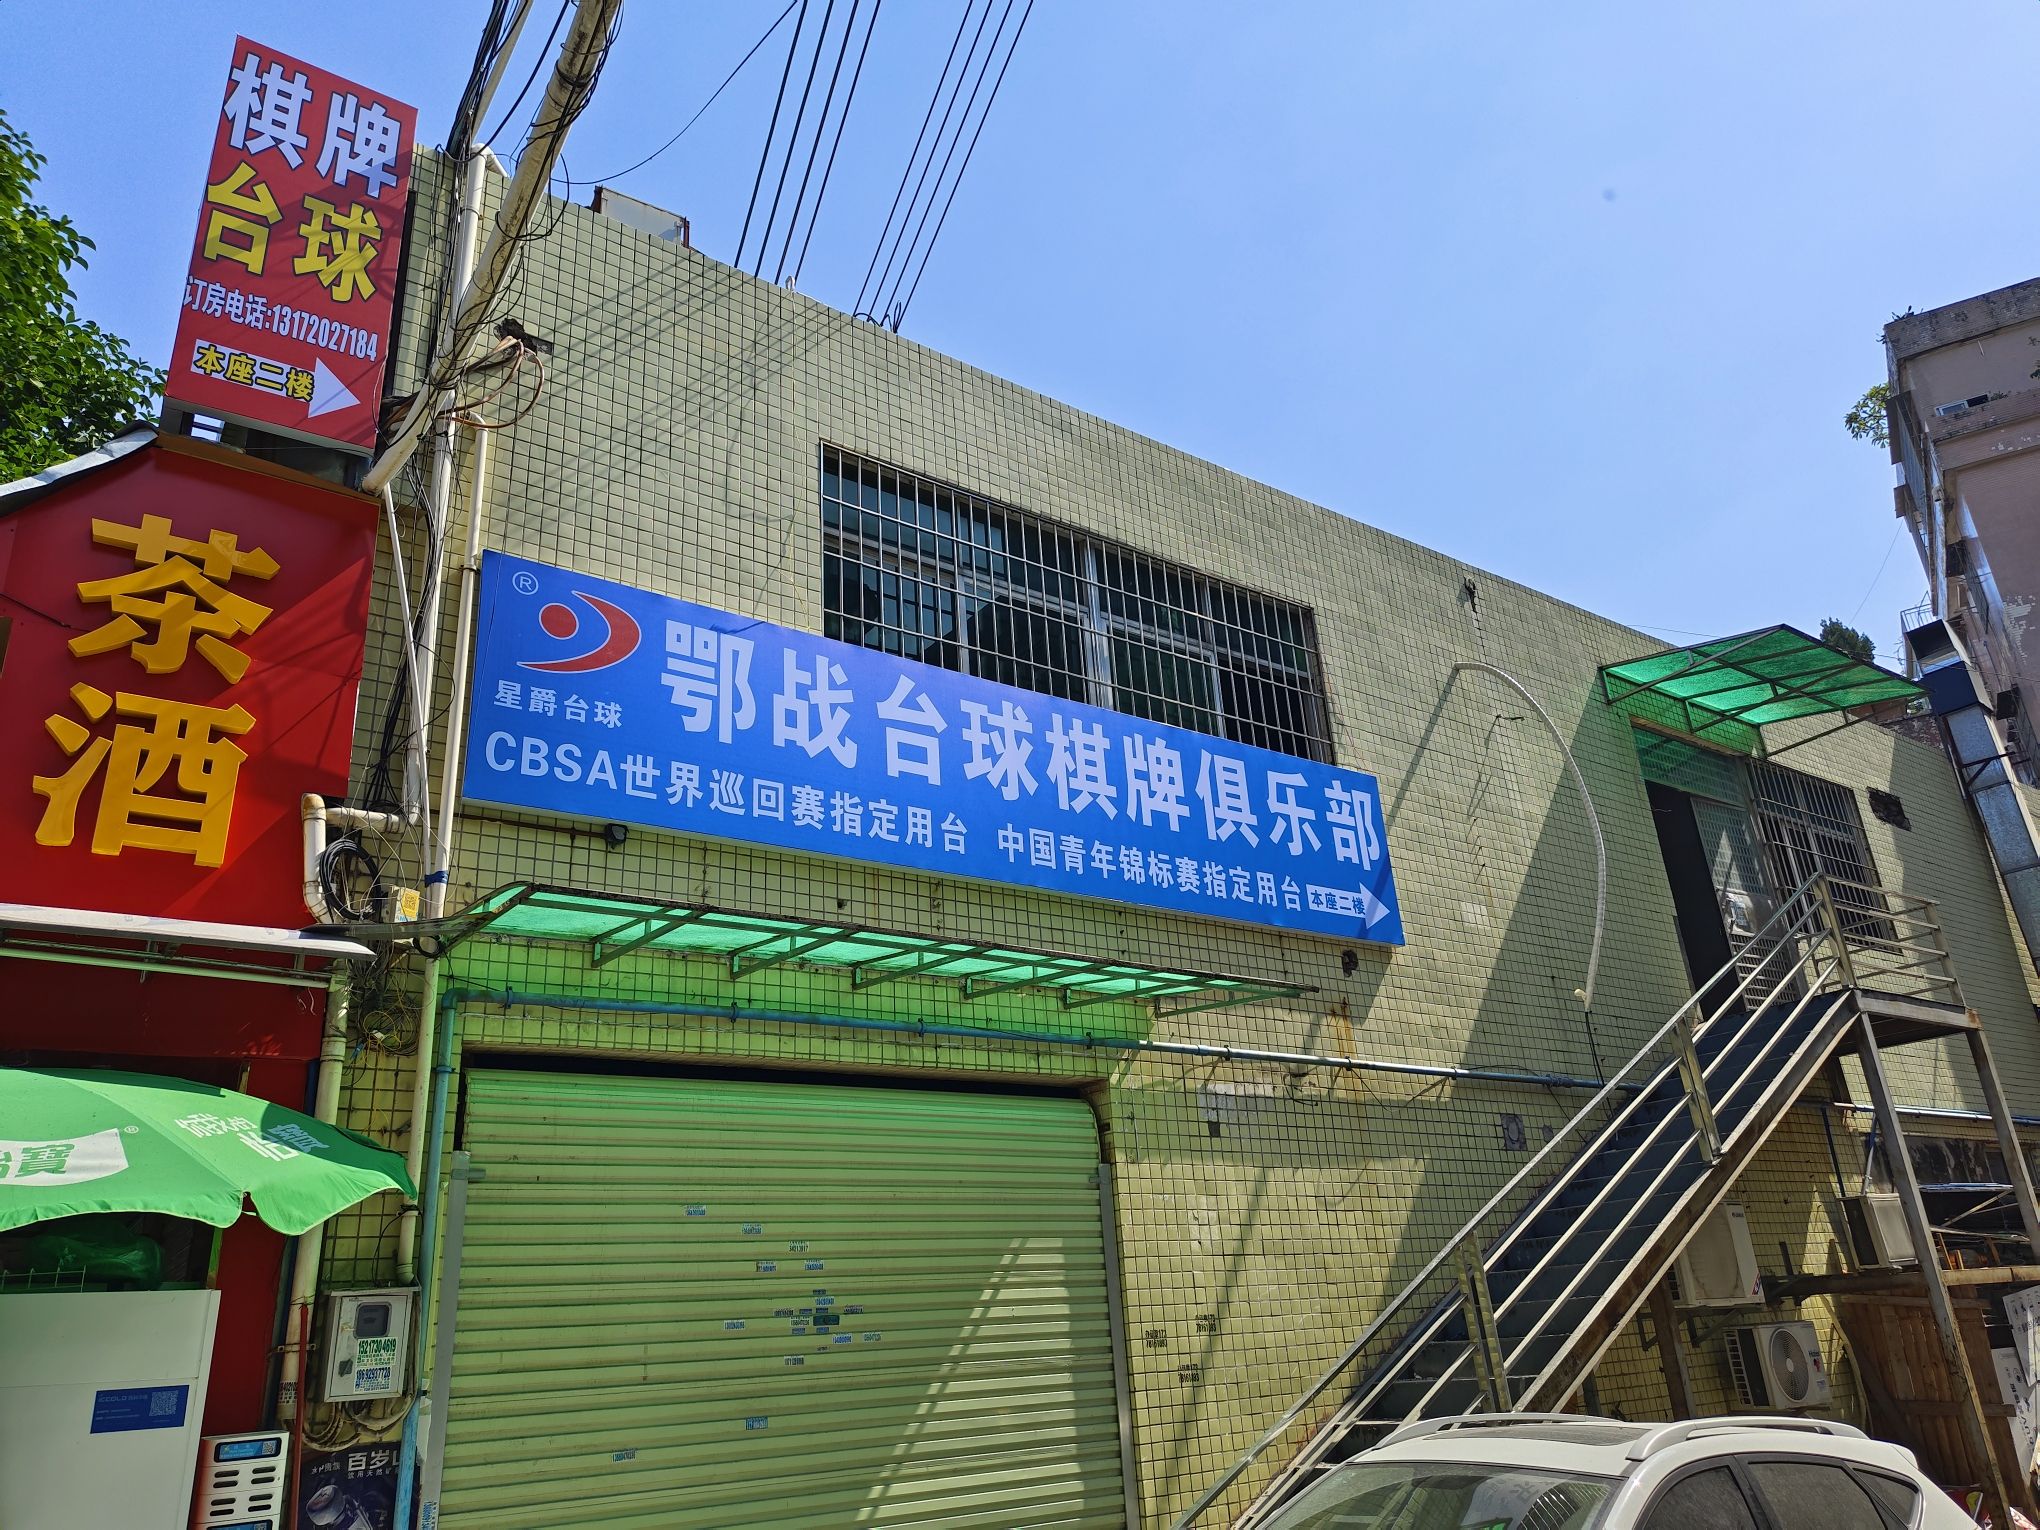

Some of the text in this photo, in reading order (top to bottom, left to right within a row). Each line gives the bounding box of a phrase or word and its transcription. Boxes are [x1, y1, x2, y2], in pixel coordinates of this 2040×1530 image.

[224, 52, 400, 198] 棋牌
[203, 161, 382, 303] 台球
[193, 345, 315, 402] 本座二楼
[493, 679, 623, 729] 星爵台球
[660, 619, 1381, 872] 鄂战台球棋牌俱乐部
[485, 730, 1302, 912] CBSA世界巡回赛指定用台 中国青年锦标赛指定用台
[1310, 888, 1366, 916] 本座二楼
